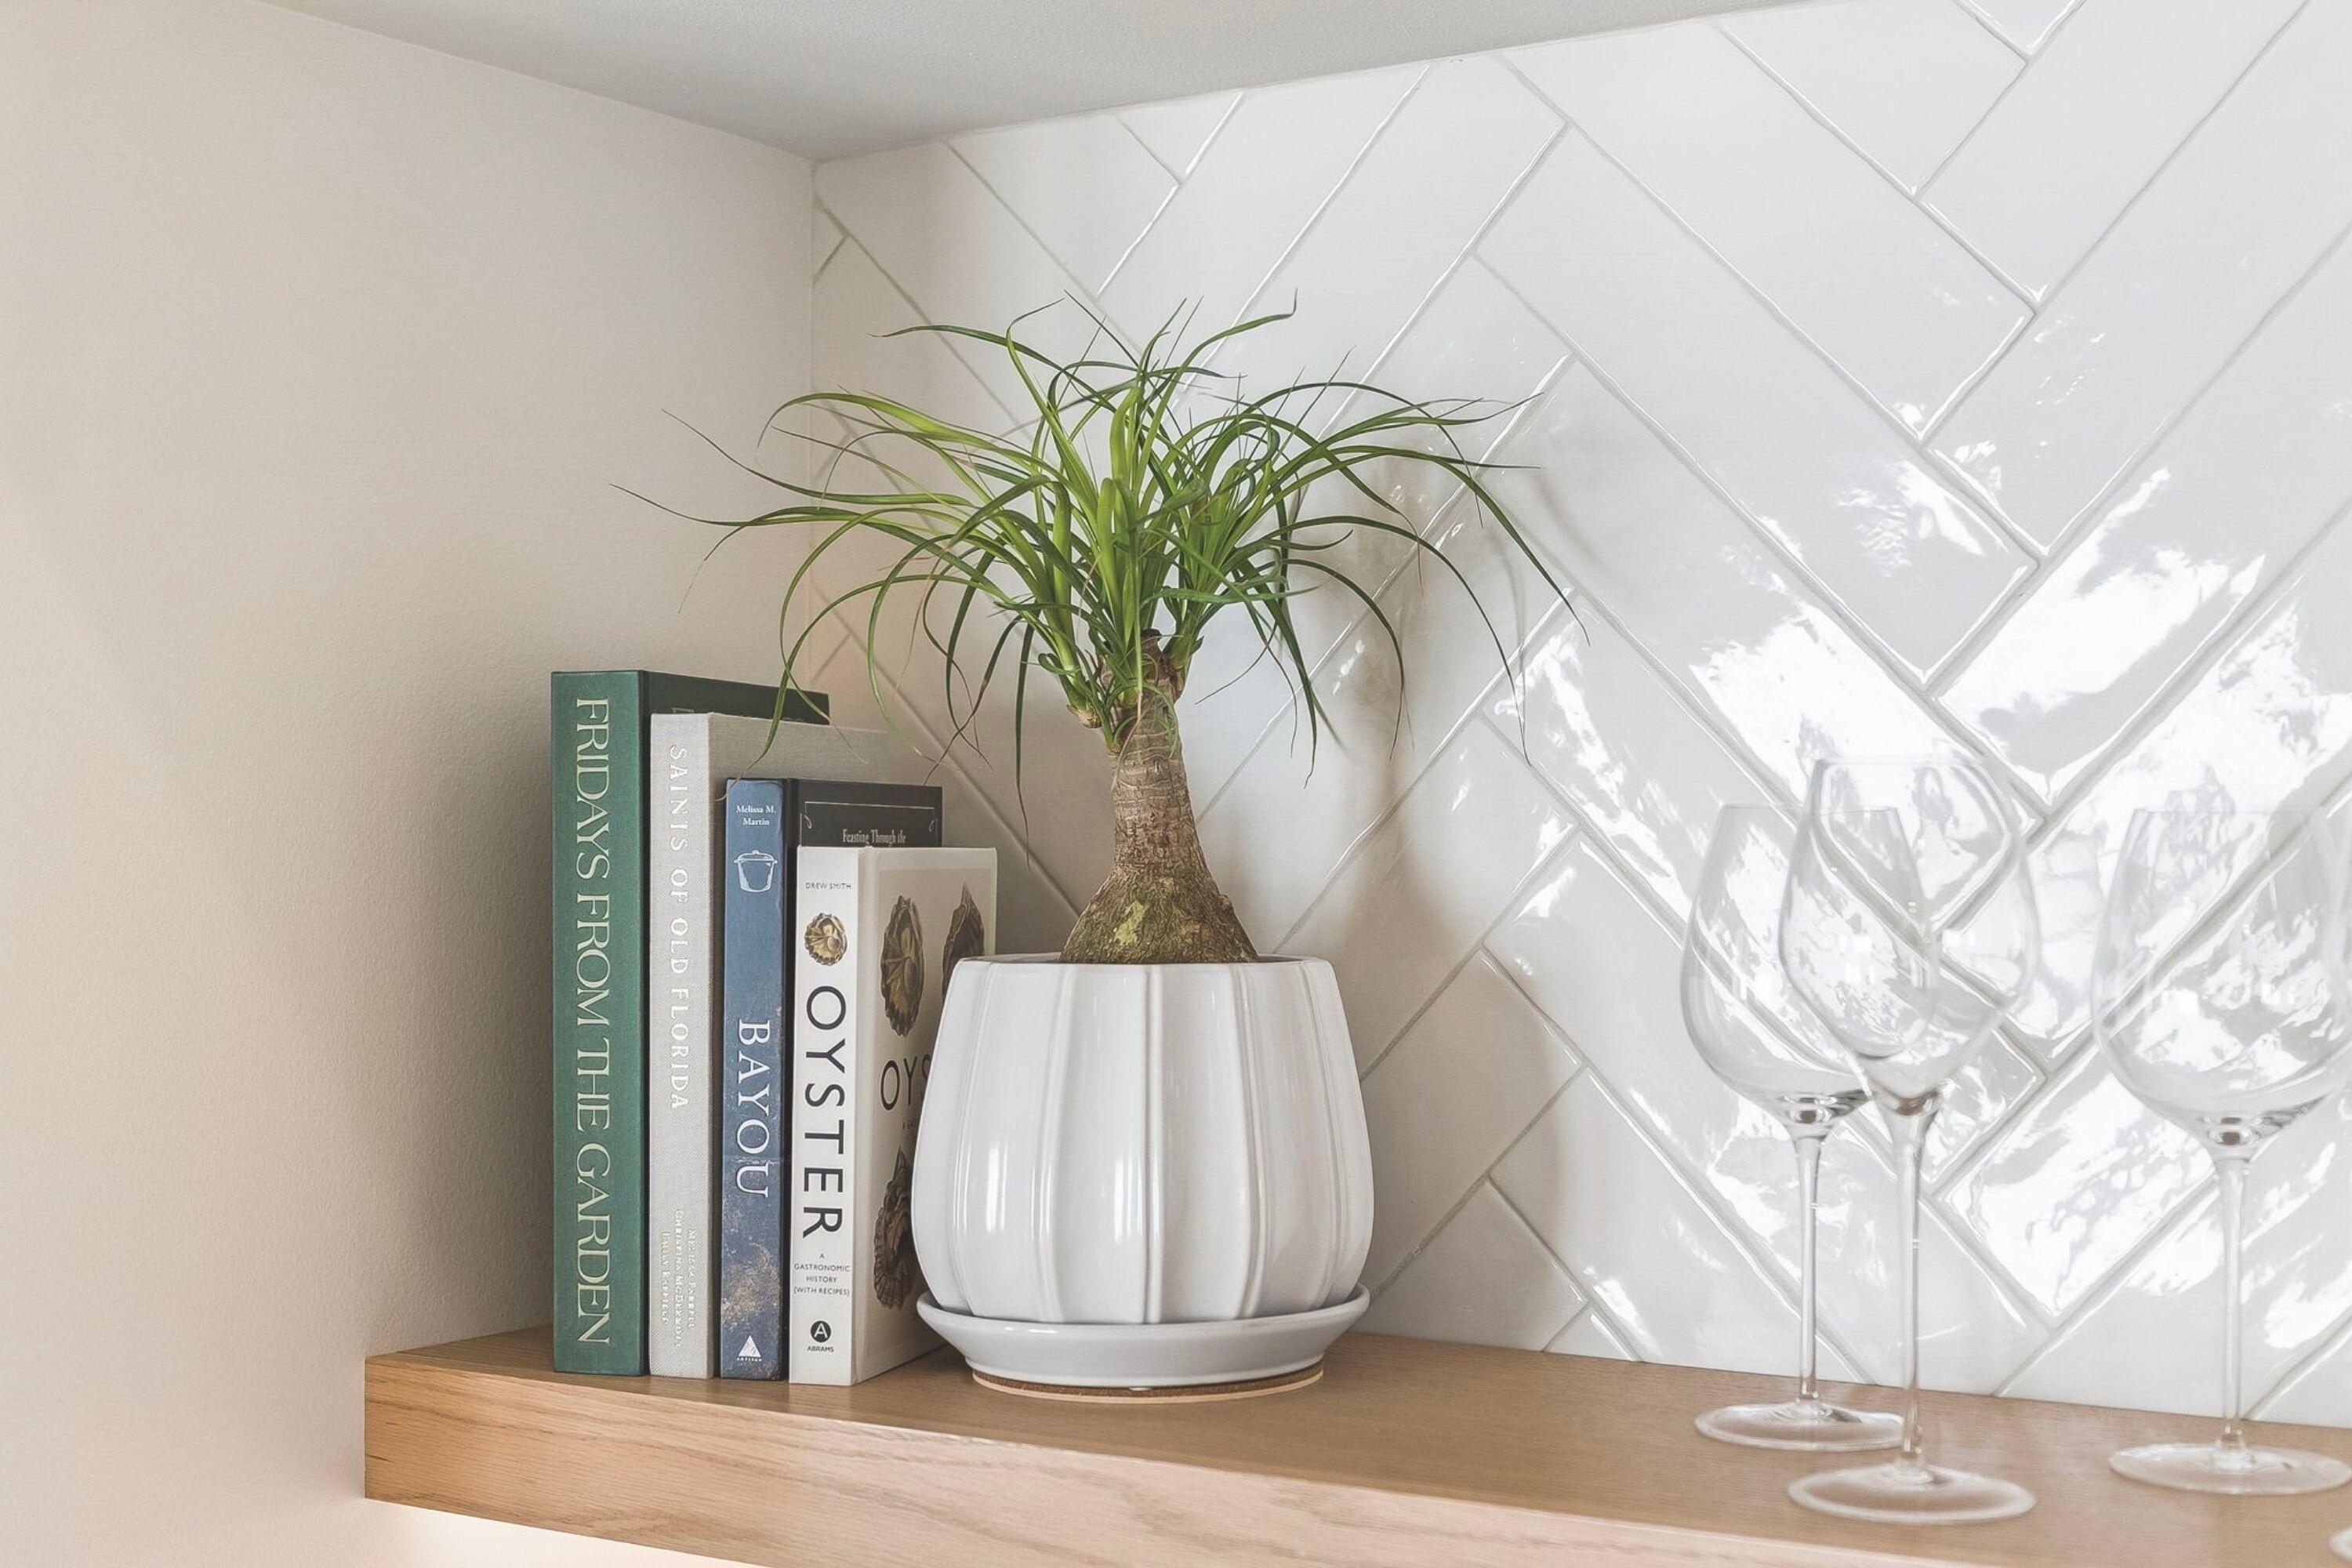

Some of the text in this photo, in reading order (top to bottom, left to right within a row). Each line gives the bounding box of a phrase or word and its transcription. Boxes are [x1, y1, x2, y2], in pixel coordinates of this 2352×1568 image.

[575, 698, 612, 1345] FRIDAYS FROM THE GARDEN
[669, 745, 690, 1109] SAINTS OF OLD FLORIDA
[735, 1019, 771, 1198] BAYOU
[802, 985, 847, 1238] OYSTER
[793, 1287, 850, 1297] (WITH RECIPES)
[794, 1263, 850, 1272] GASTRONOMIC
